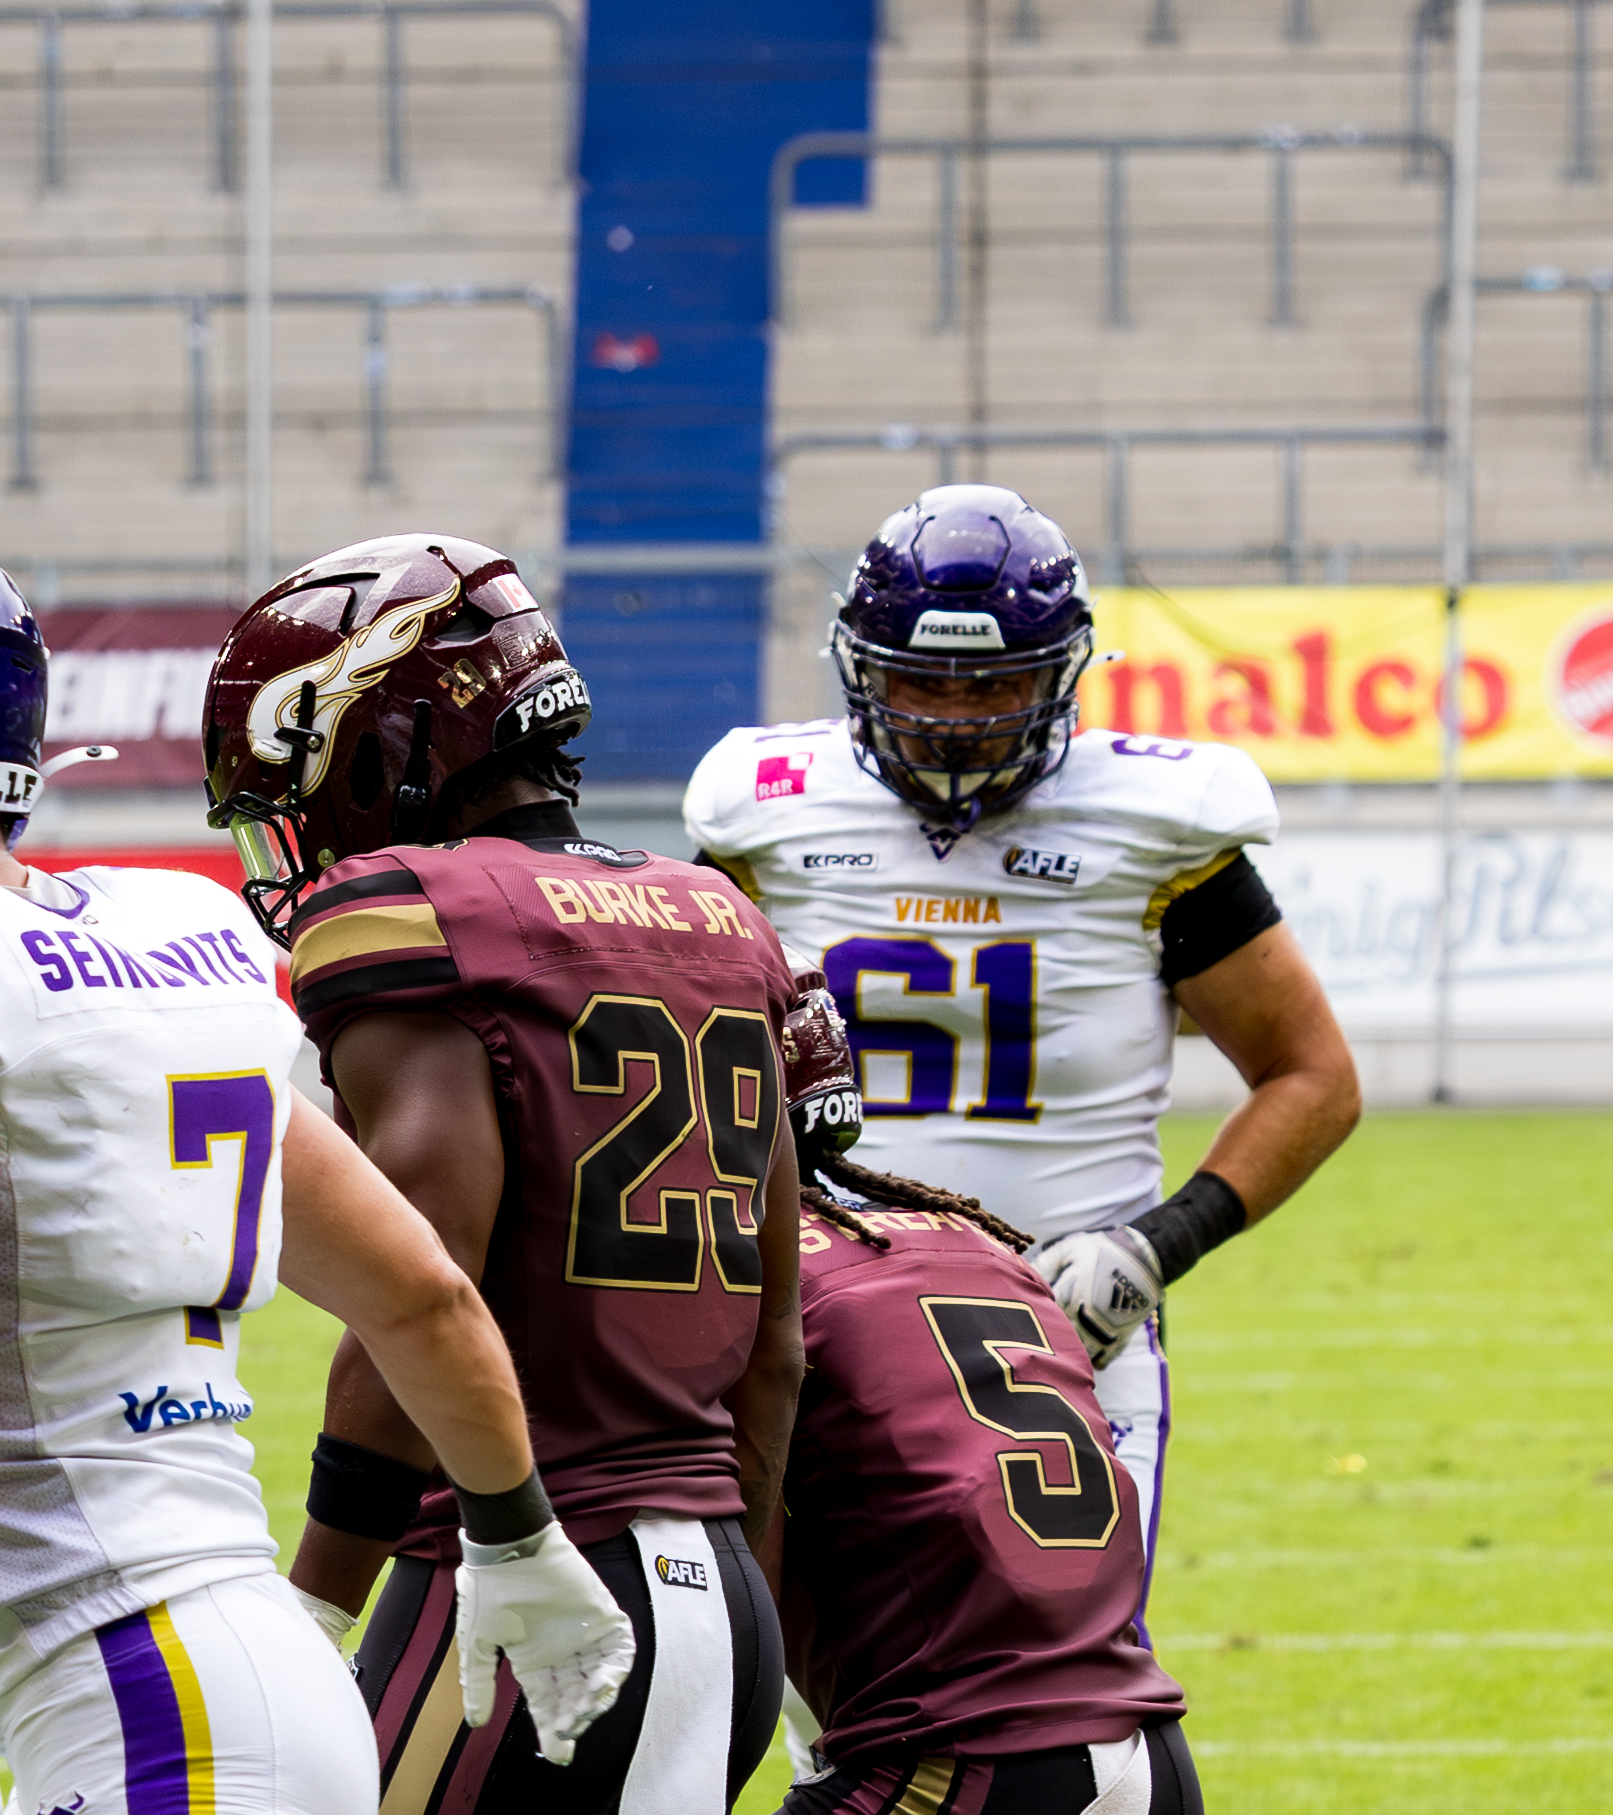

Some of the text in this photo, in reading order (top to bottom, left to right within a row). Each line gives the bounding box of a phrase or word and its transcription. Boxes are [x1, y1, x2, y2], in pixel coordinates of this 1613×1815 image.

[920, 623, 992, 636] FORELLE
[437, 658, 487, 709] 29
[516, 677, 591, 733] FORE
[1076, 629, 1512, 742] nalco
[757, 779, 794, 799] R4R
[1011, 850, 1081, 878] AFLE
[535, 877, 754, 940] BURKE JR.
[895, 896, 1002, 924] VIENNA
[822, 934, 1043, 1124] 61
[563, 991, 781, 1295] 29
[166, 1067, 277, 1349] 7
[920, 1295, 1121, 1550] 5
[667, 1560, 707, 1587] AFLE
